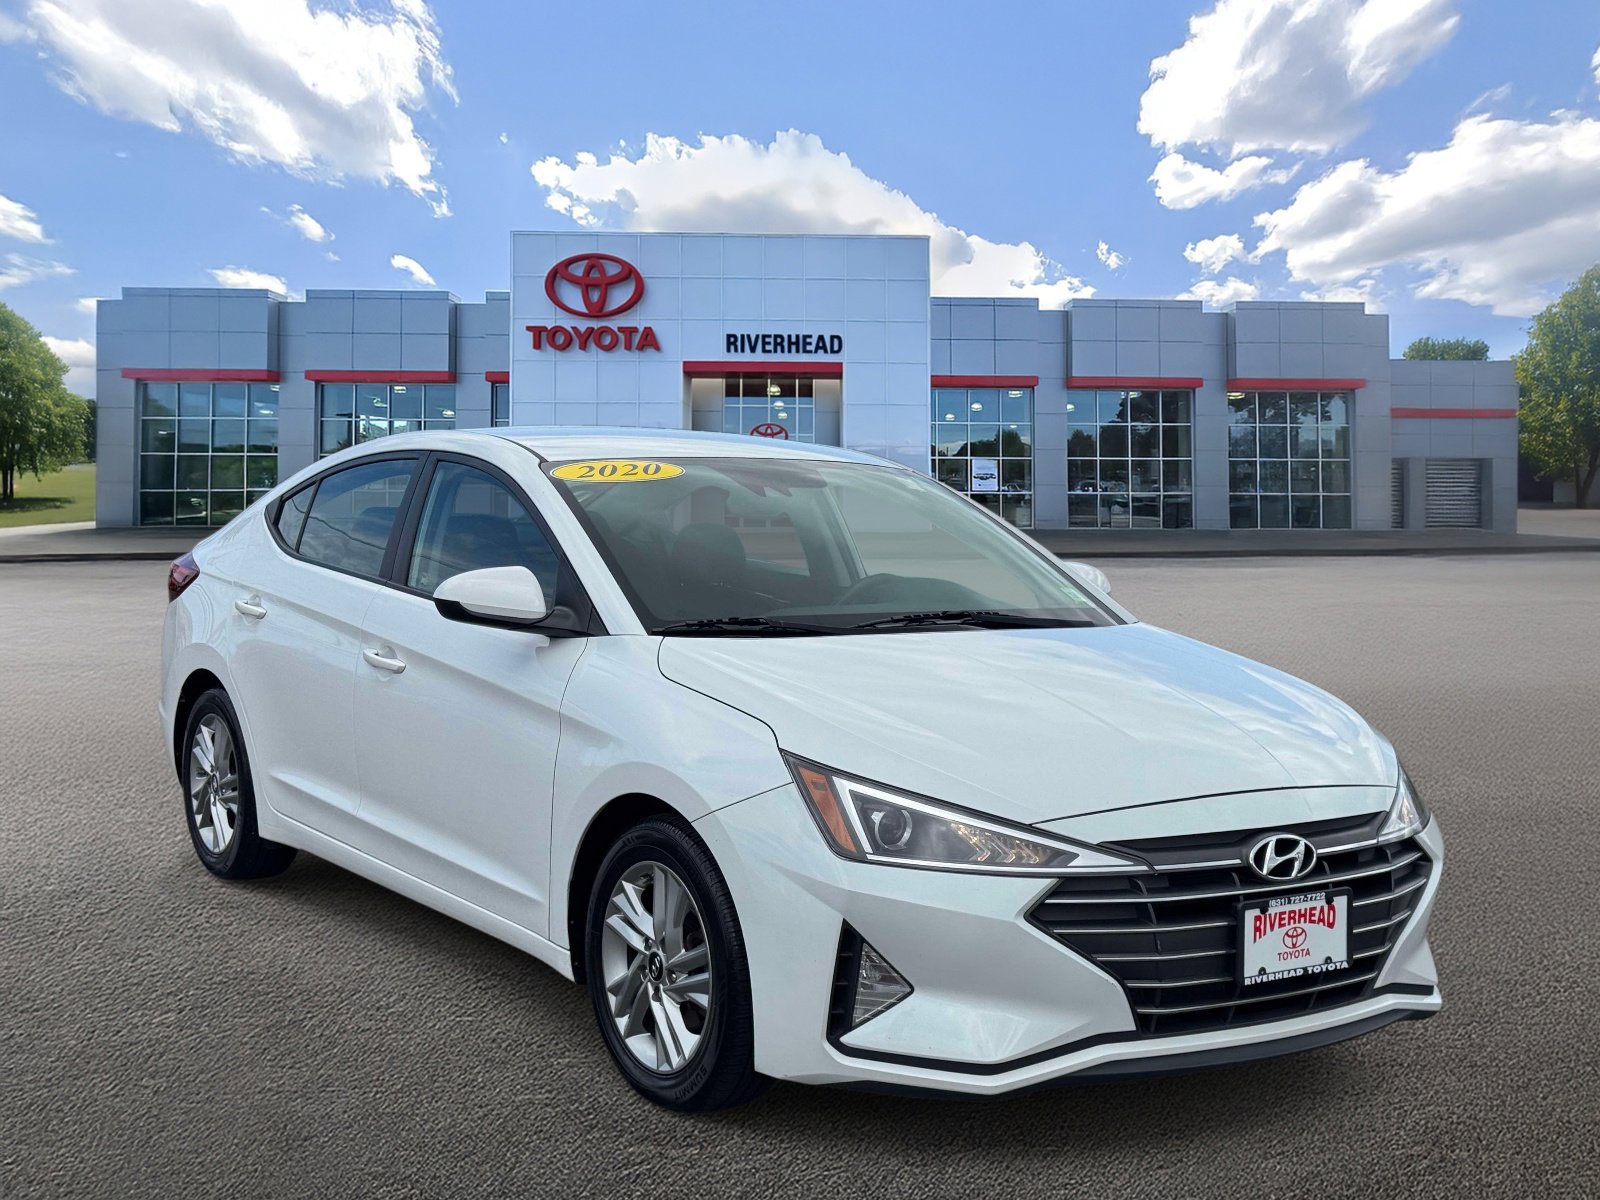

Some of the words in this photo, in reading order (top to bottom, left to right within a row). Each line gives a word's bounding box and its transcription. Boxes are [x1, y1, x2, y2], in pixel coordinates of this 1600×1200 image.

[526, 325, 661, 351] TOYOTA
[726, 333, 843, 354] RIVERHEAD
[577, 463, 661, 478] 2020
[1268, 897, 1288, 907] (631)
[1253, 902, 1336, 944] RIVERHEAD
[1277, 948, 1311, 961] TOYOTA
[1244, 968, 1304, 986] RIVERHEAD
[1307, 961, 1349, 975] TOYOTA
[674, 1064, 708, 1101] SUMMIT
